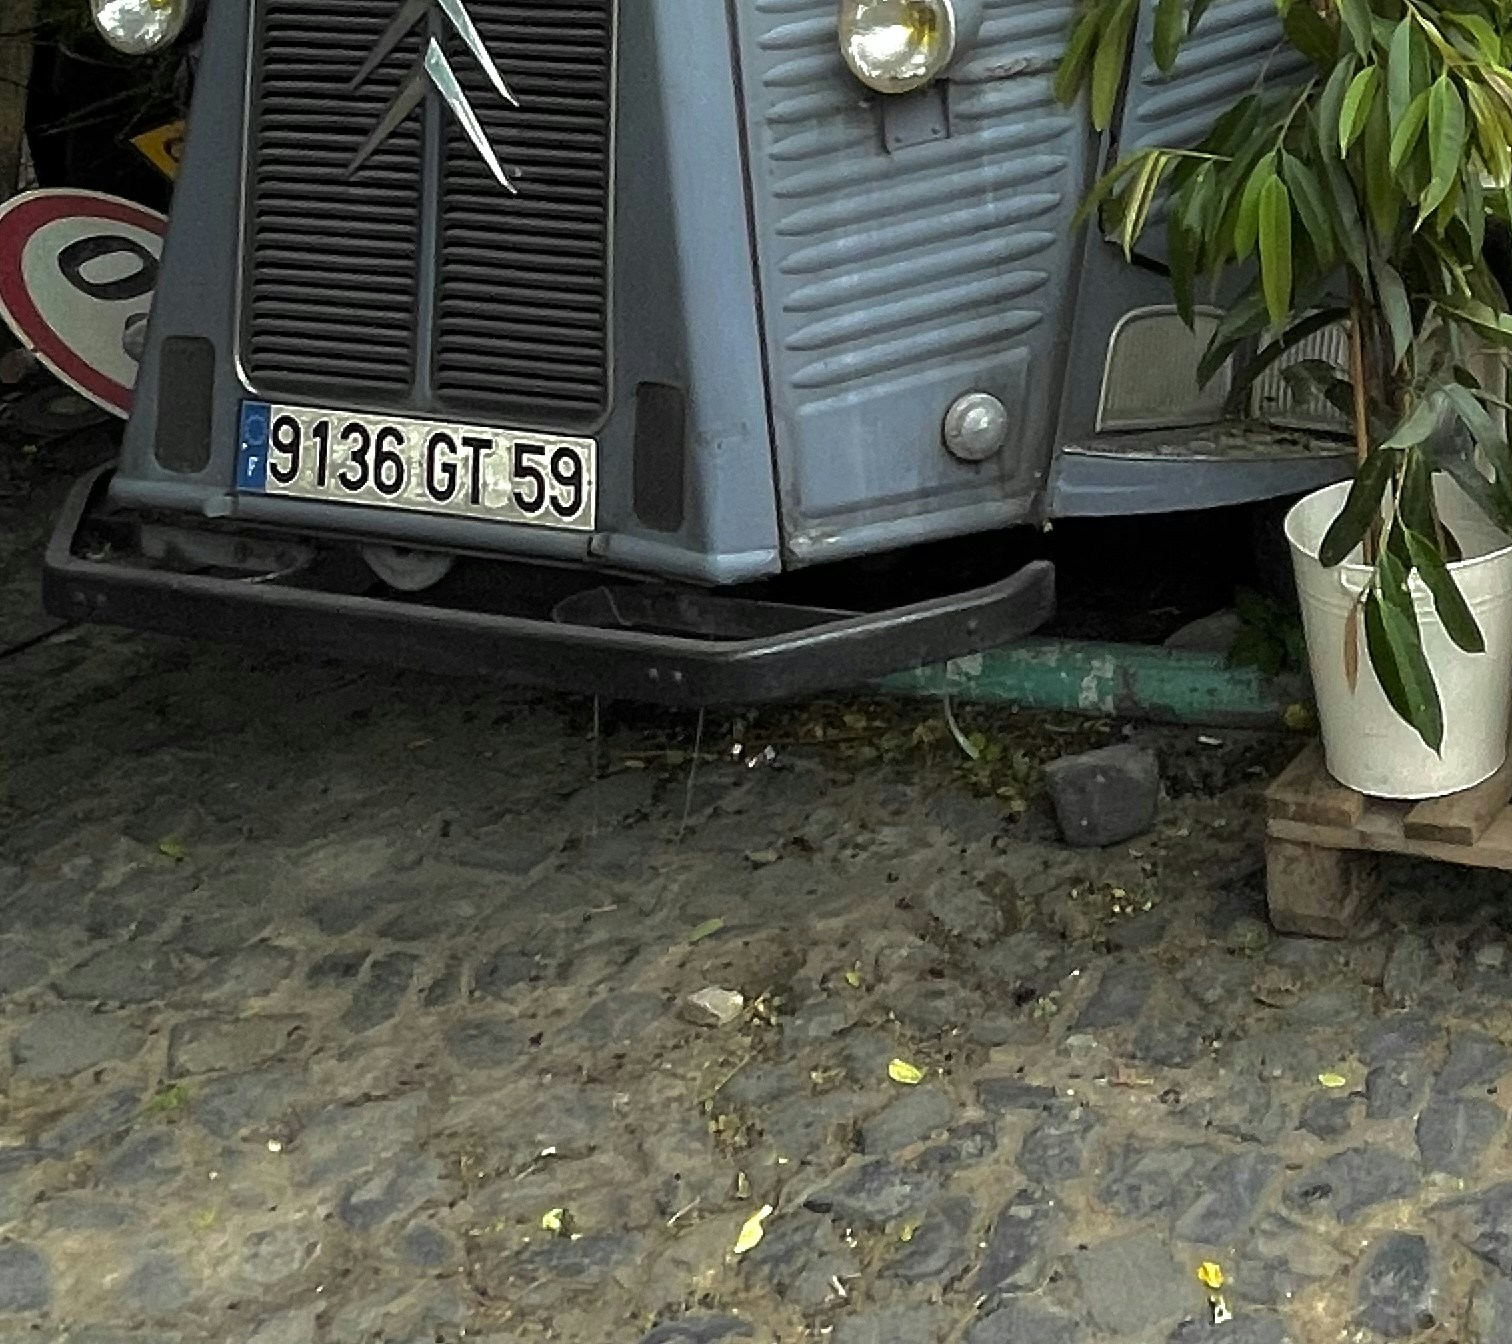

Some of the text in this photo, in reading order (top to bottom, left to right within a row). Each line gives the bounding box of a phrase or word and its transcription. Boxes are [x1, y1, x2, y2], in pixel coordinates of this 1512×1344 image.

[269, 414, 584, 518] 9136 GT 59
